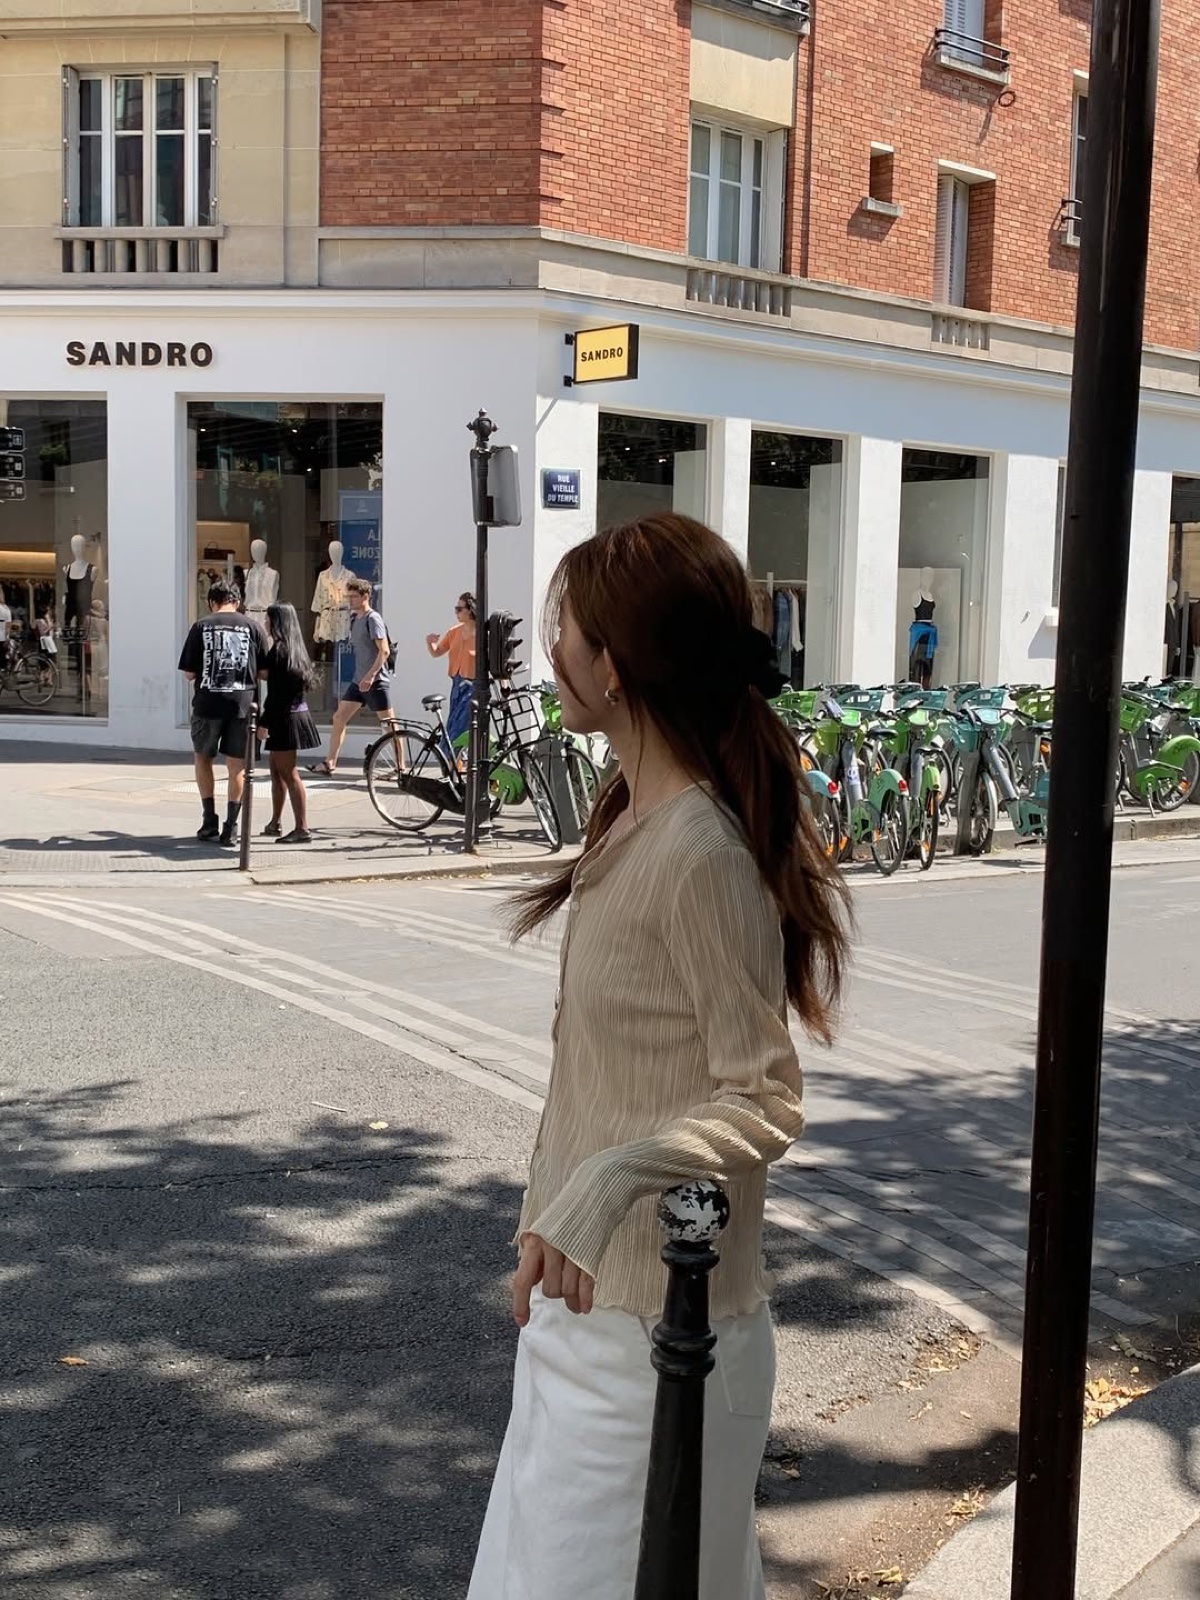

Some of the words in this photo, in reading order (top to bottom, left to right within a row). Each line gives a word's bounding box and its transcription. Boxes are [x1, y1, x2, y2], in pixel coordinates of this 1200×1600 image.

[66, 341, 213, 367] SANDRO
[581, 346, 623, 362] SANDRO
[557, 474, 570, 483] RUE
[552, 484, 575, 493] VIEILLE
[547, 494, 557, 502] DU
[557, 494, 578, 503] TEMPLE
